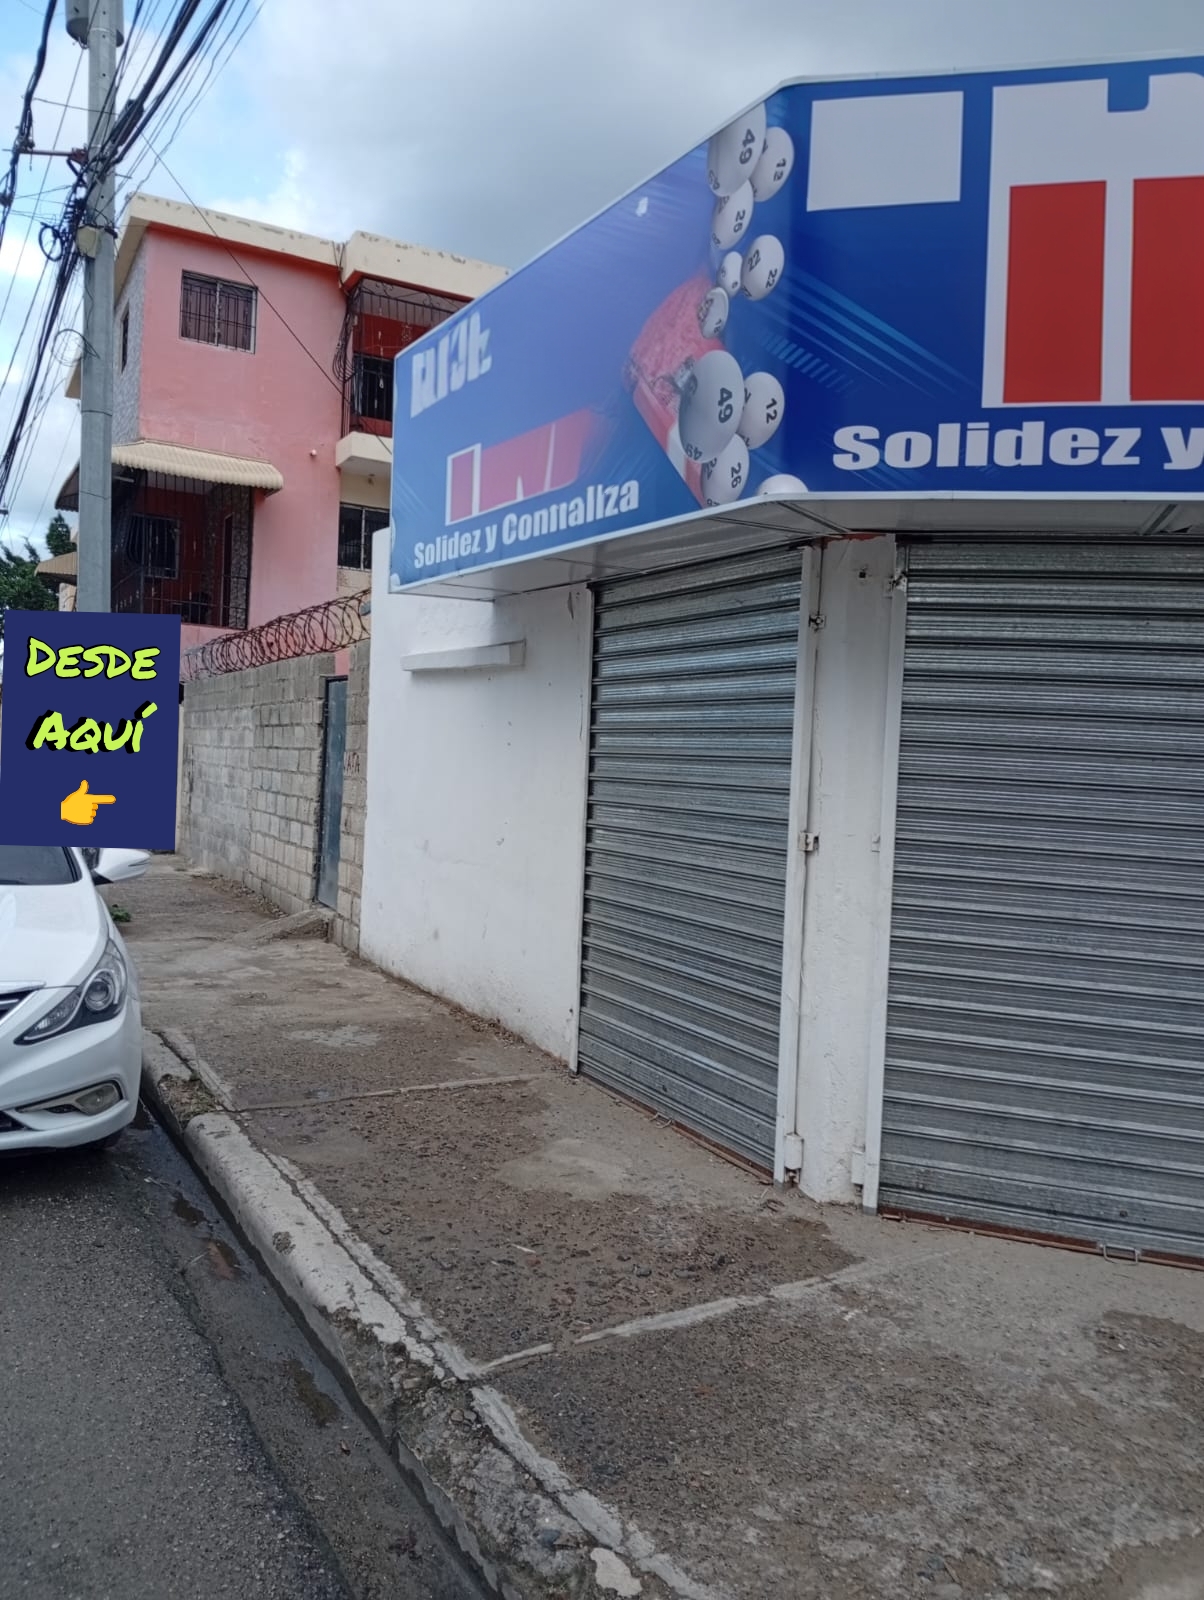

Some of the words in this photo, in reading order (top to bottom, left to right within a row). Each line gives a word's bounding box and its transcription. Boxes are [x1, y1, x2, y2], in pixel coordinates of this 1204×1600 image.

[717, 387, 734, 424] 49
[765, 398, 778, 424] 12
[833, 421, 1142, 471] Solidez
[1160, 427, 1204, 470] y
[730, 462, 742, 489] 26
[414, 527, 481, 569] Solidez
[485, 523, 497, 553] y
